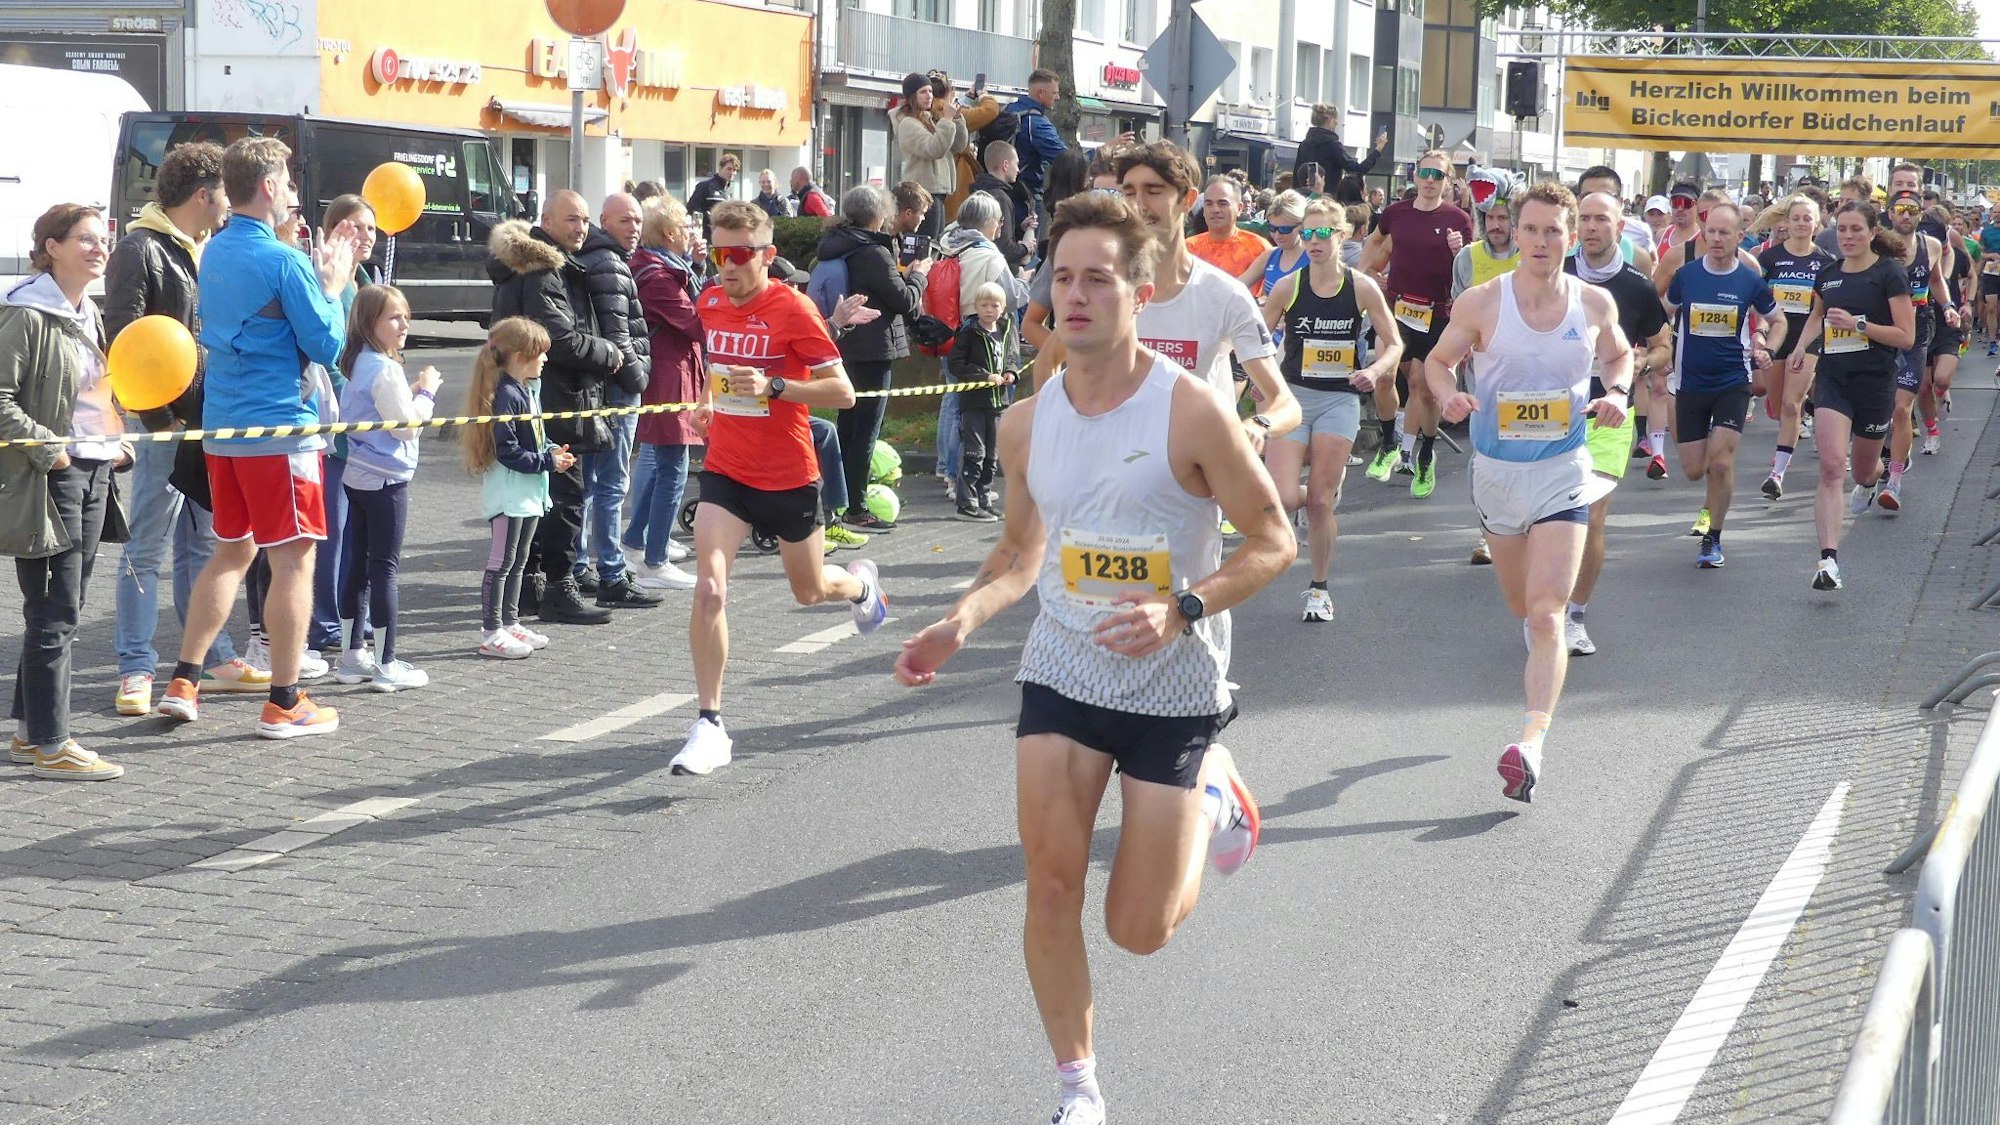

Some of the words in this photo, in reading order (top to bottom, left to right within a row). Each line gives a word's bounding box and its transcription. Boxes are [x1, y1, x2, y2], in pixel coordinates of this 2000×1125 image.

[113, 17, 157, 29] STRÖER
[72, 59, 91, 70] COLIN
[92, 59, 119, 71] FARRELL
[1630, 80, 1732, 100] Herzlich
[1741, 82, 1898, 104] Willkommen
[1908, 86, 1971, 105] beim
[1632, 107, 1794, 129] Bickendorfer
[1803, 112, 1966, 133] Büdchenlauf
[1783, 292, 1802, 301] 752
[1401, 306, 1425, 319] 1337
[1699, 312, 1729, 324] 1284
[1314, 317, 1355, 330] bunert
[1317, 350, 1342, 362] 950
[1516, 403, 1549, 420] 201
[1080, 552, 1149, 581] 1238
